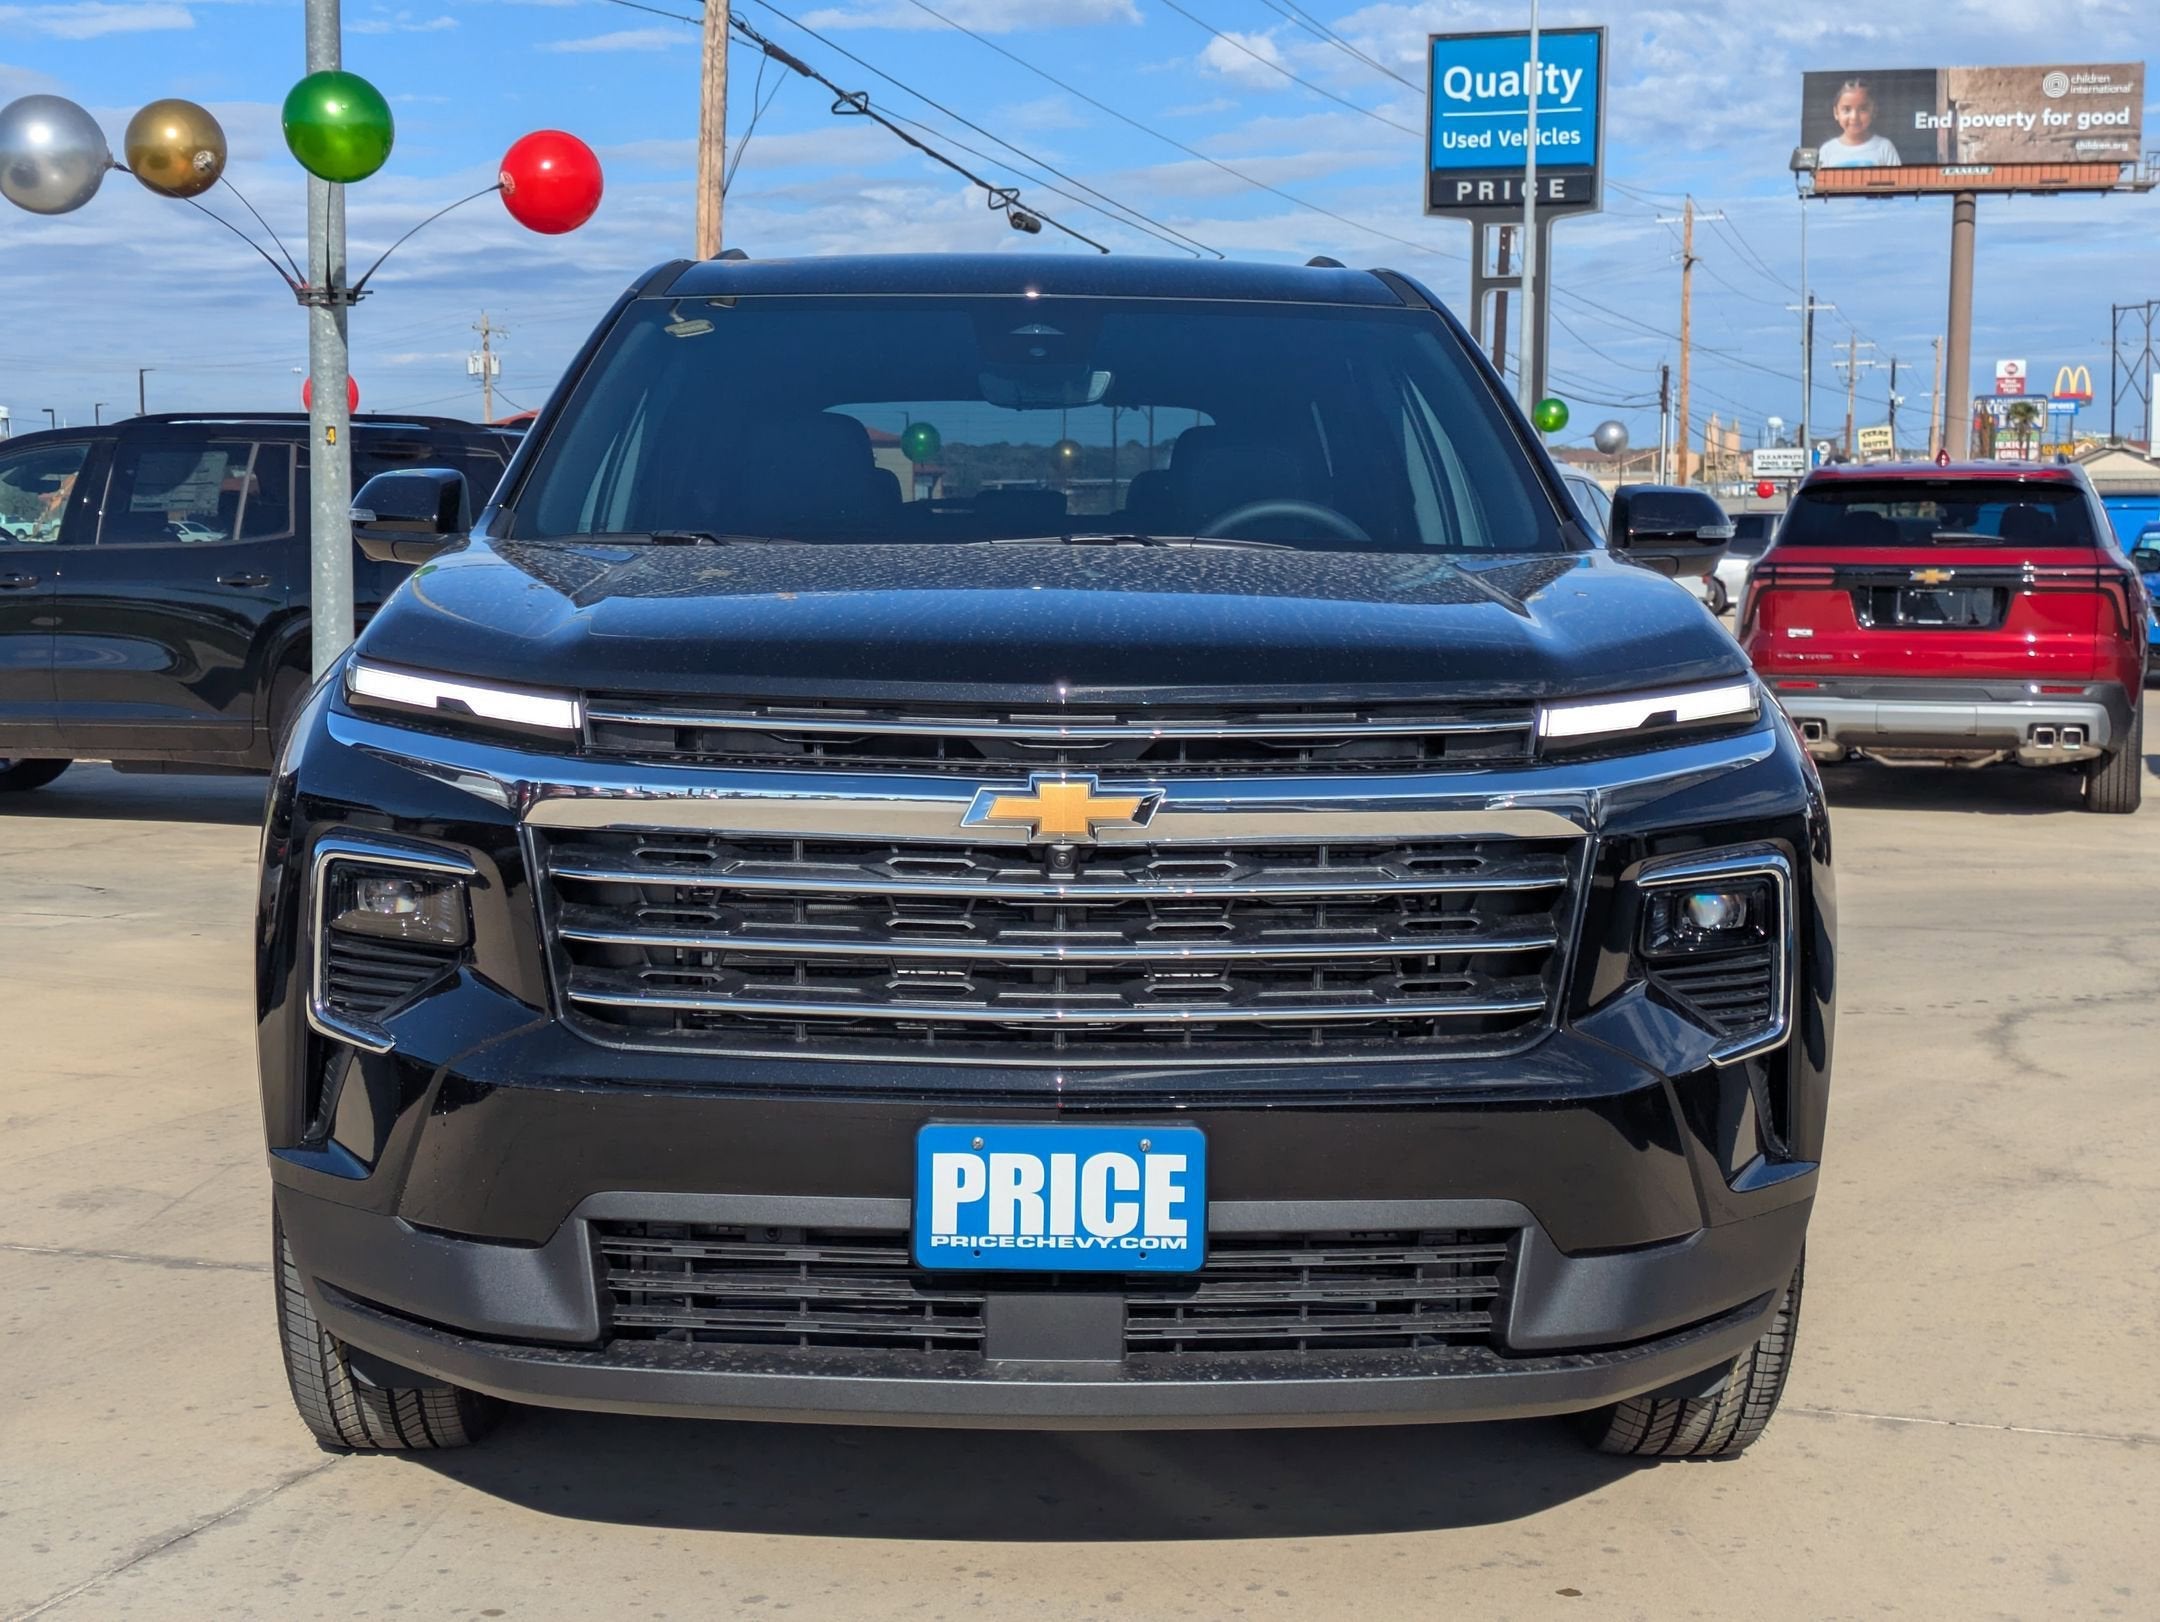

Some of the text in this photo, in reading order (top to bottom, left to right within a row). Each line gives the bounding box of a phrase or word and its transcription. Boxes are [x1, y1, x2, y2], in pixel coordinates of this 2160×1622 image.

[1443, 62, 1583, 104] Quality
[2070, 73, 2111, 84] children
[2070, 82, 2131, 94] international
[1915, 106, 2130, 131] End poverty for good
[1442, 130, 1491, 148] Used
[2075, 139, 2128, 152] children.org
[1457, 178, 1565, 201] PRICE
[931, 1151, 1187, 1237] PRICE
[930, 1235, 1187, 1250] PRICECHEVY.COM
